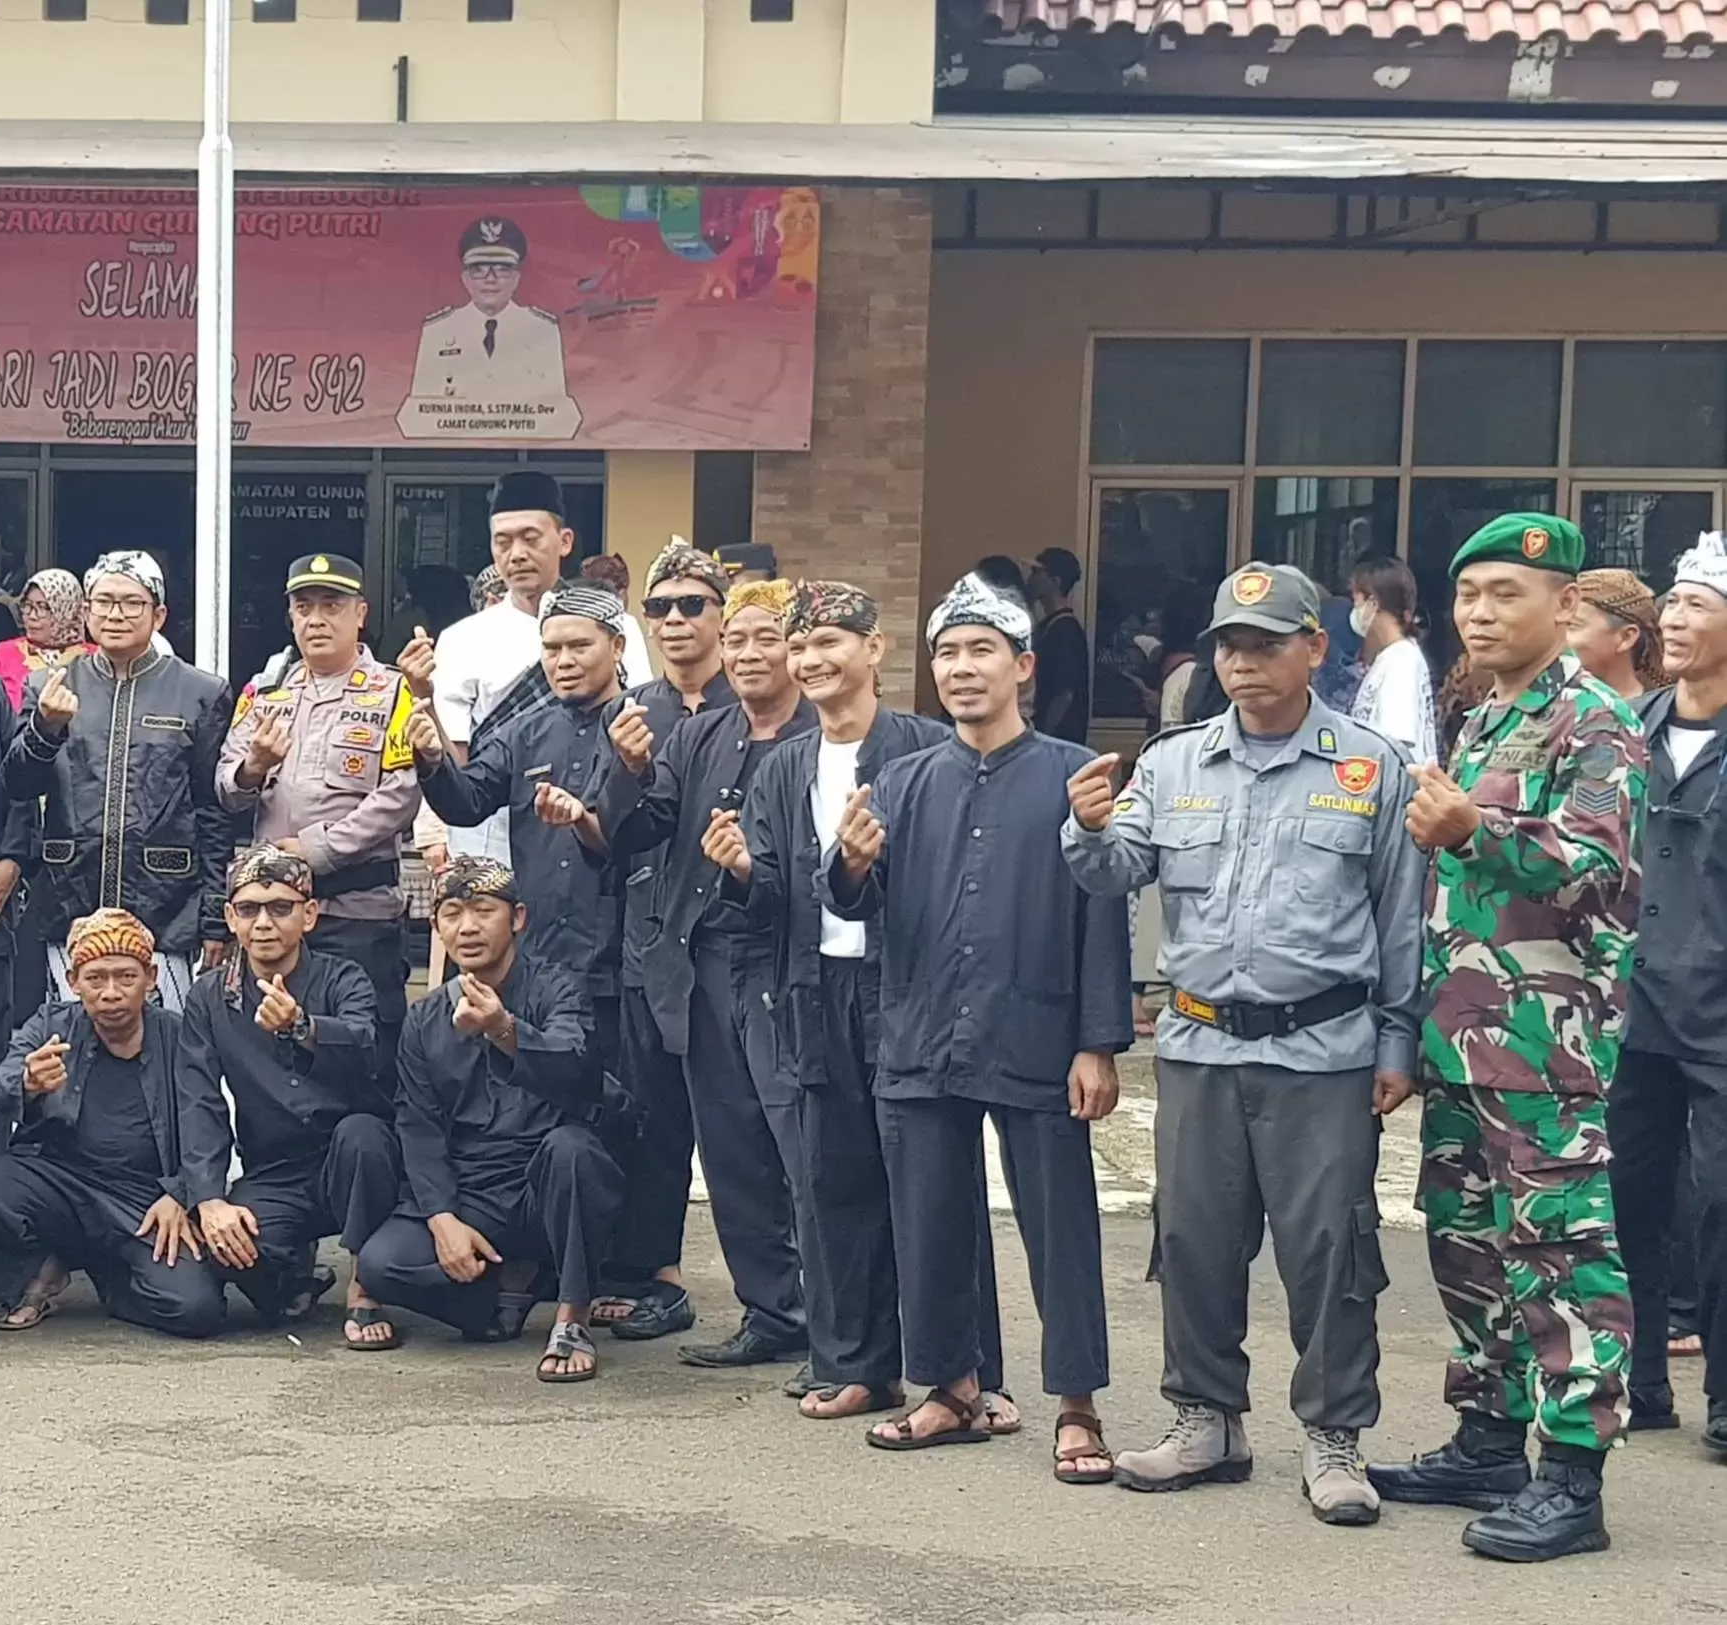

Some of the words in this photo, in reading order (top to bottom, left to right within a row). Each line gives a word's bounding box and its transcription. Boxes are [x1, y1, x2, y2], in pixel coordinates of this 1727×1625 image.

[142, 210, 281, 241] GUNG
[286, 211, 383, 238] PUTRI
[43, 350, 119, 409] JADI
[250, 353, 296, 412] KE
[304, 354, 365, 414] 542
[418, 403, 453, 414] KURNIA
[436, 419, 467, 430] CAMAT
[468, 419, 507, 430] GUNUNG
[508, 419, 536, 430] PUTRI
[233, 505, 330, 520] ABUPATEN
[340, 710, 386, 726] POLRI
